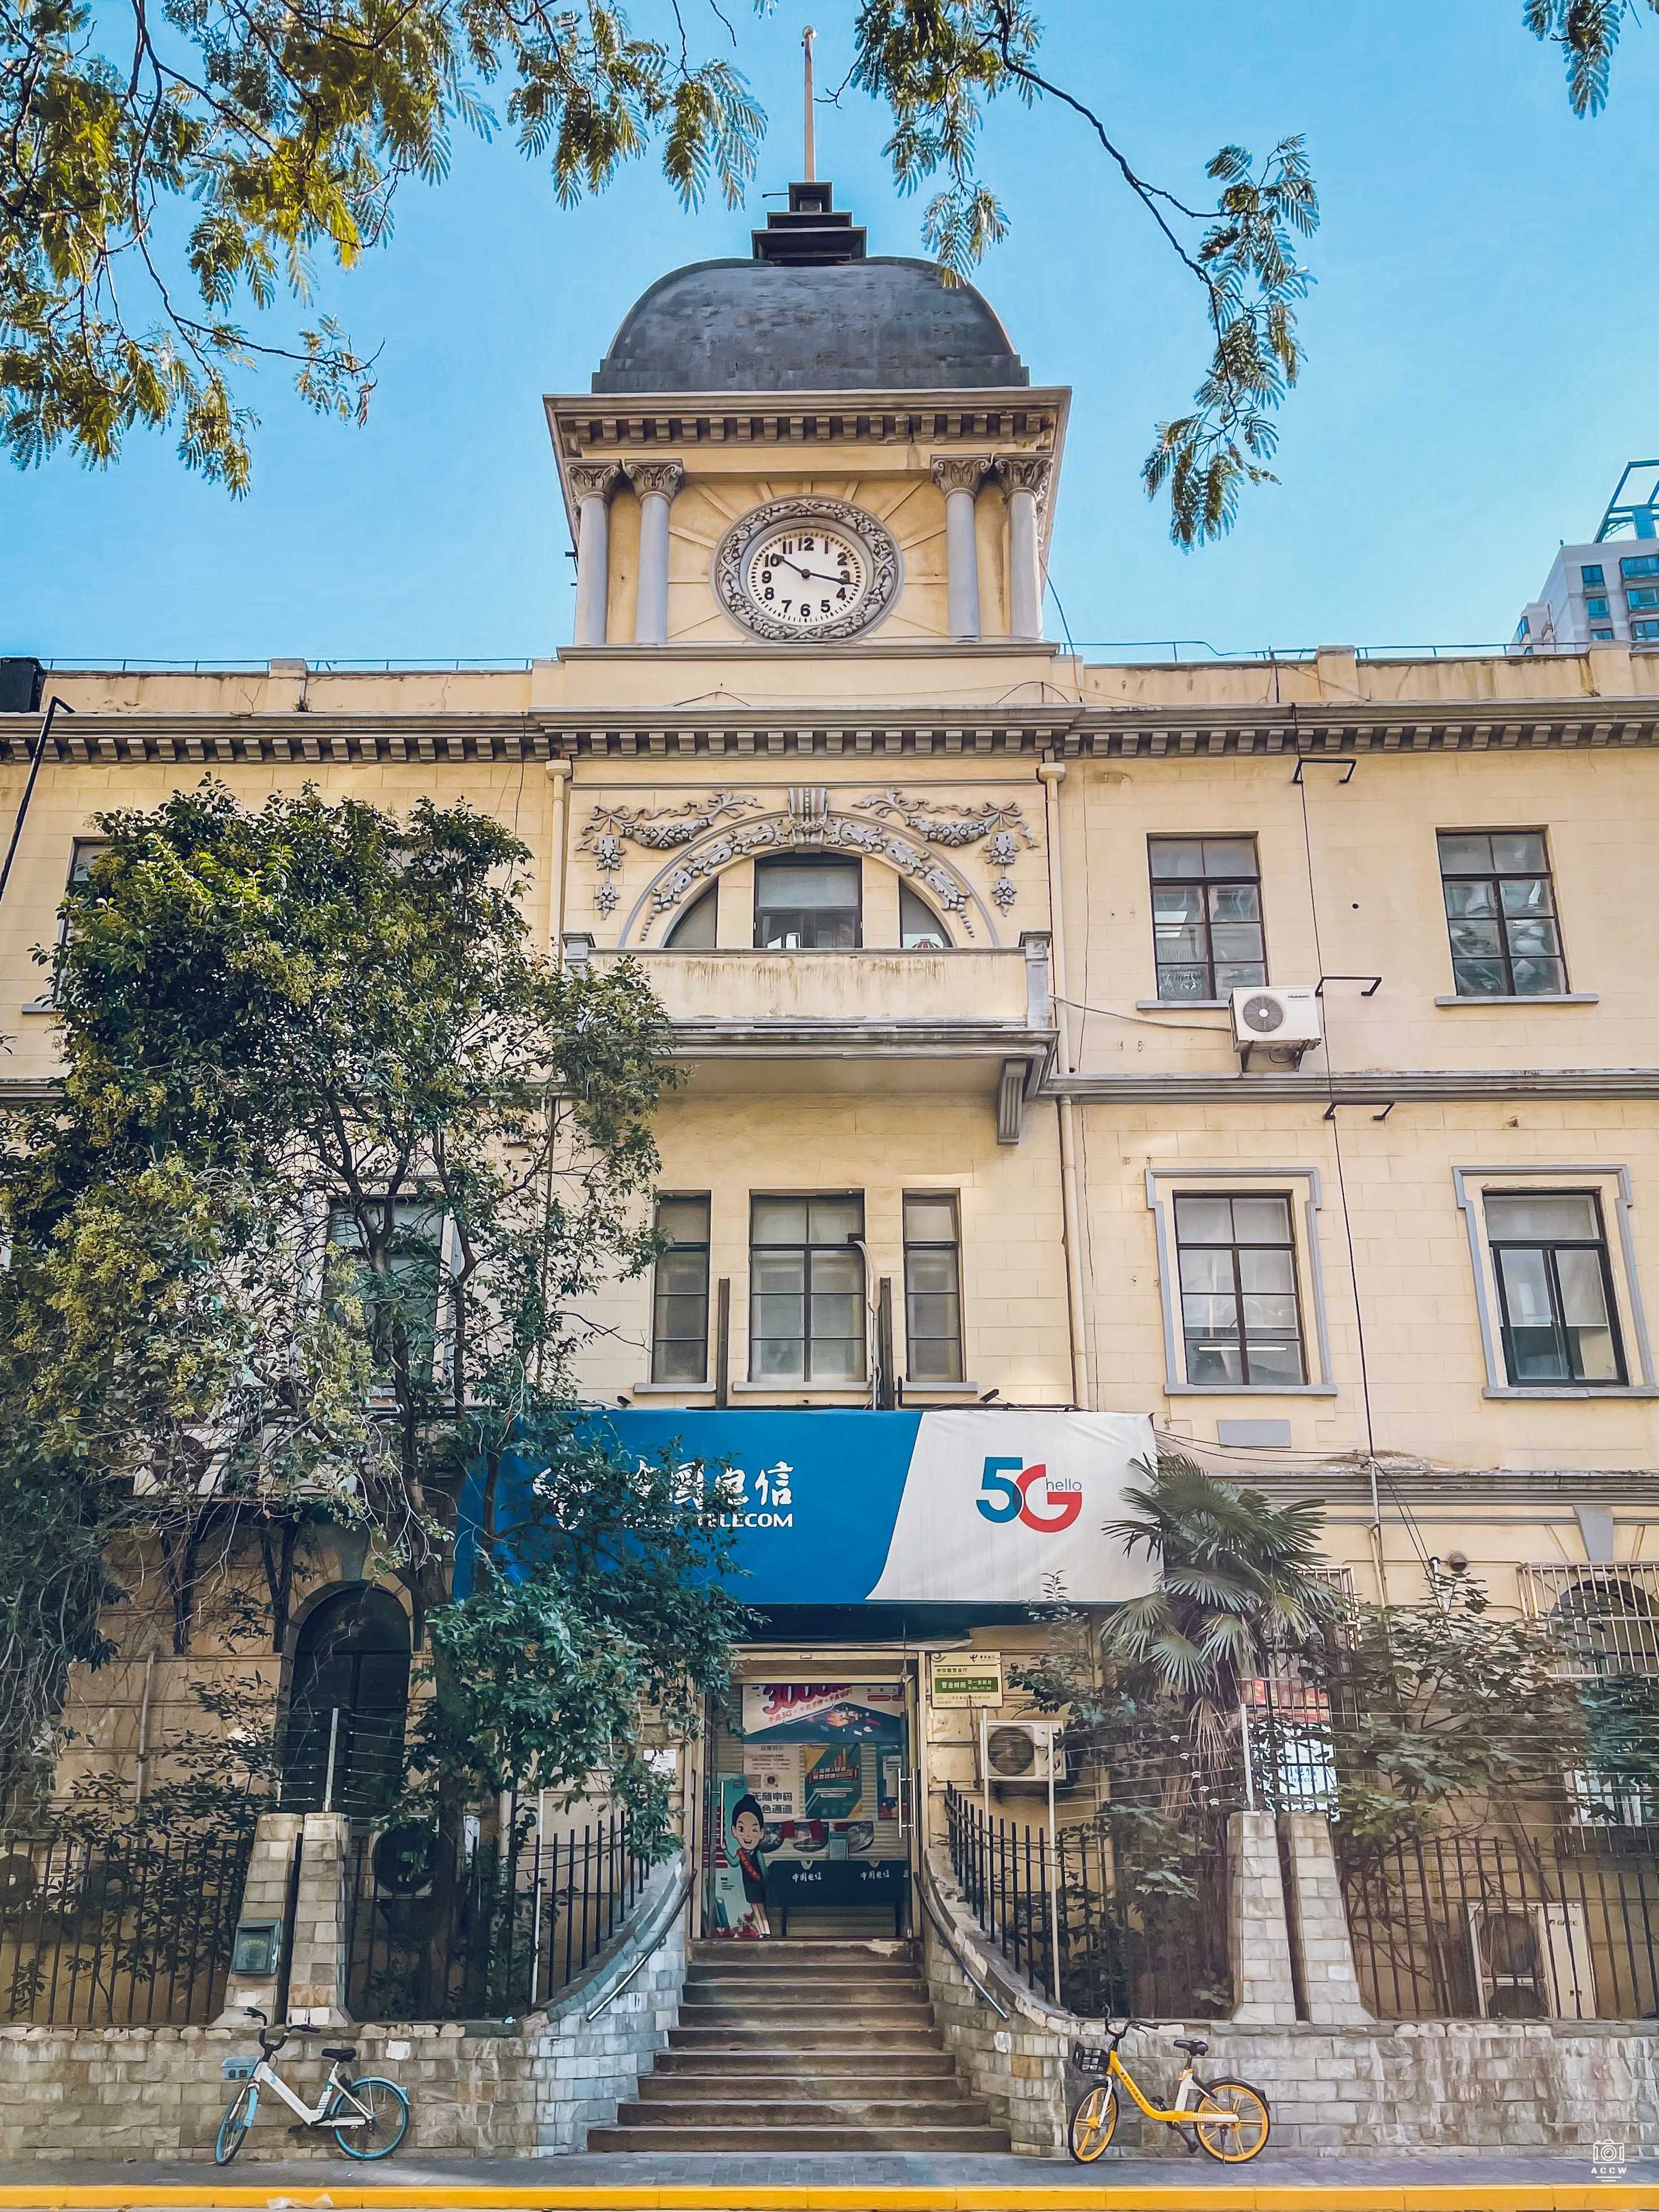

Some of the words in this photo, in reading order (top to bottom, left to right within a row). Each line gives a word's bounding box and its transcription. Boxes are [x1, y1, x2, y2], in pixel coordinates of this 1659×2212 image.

[783, 541, 792, 554] 11
[798, 537, 815, 551] 12
[825, 541, 828, 554] 1
[764, 553, 782, 567] 10
[837, 553, 847, 566] 2
[762, 570, 771, 584] 9
[840, 569, 850, 583] 3
[764, 587, 774, 600] 8
[836, 587, 846, 601] 4
[782, 599, 792, 613] 7
[801, 604, 810, 617] 6
[821, 599, 830, 613] 5
[1046, 1478, 1082, 1491] hello
[976, 1456, 1082, 1533] 5G
